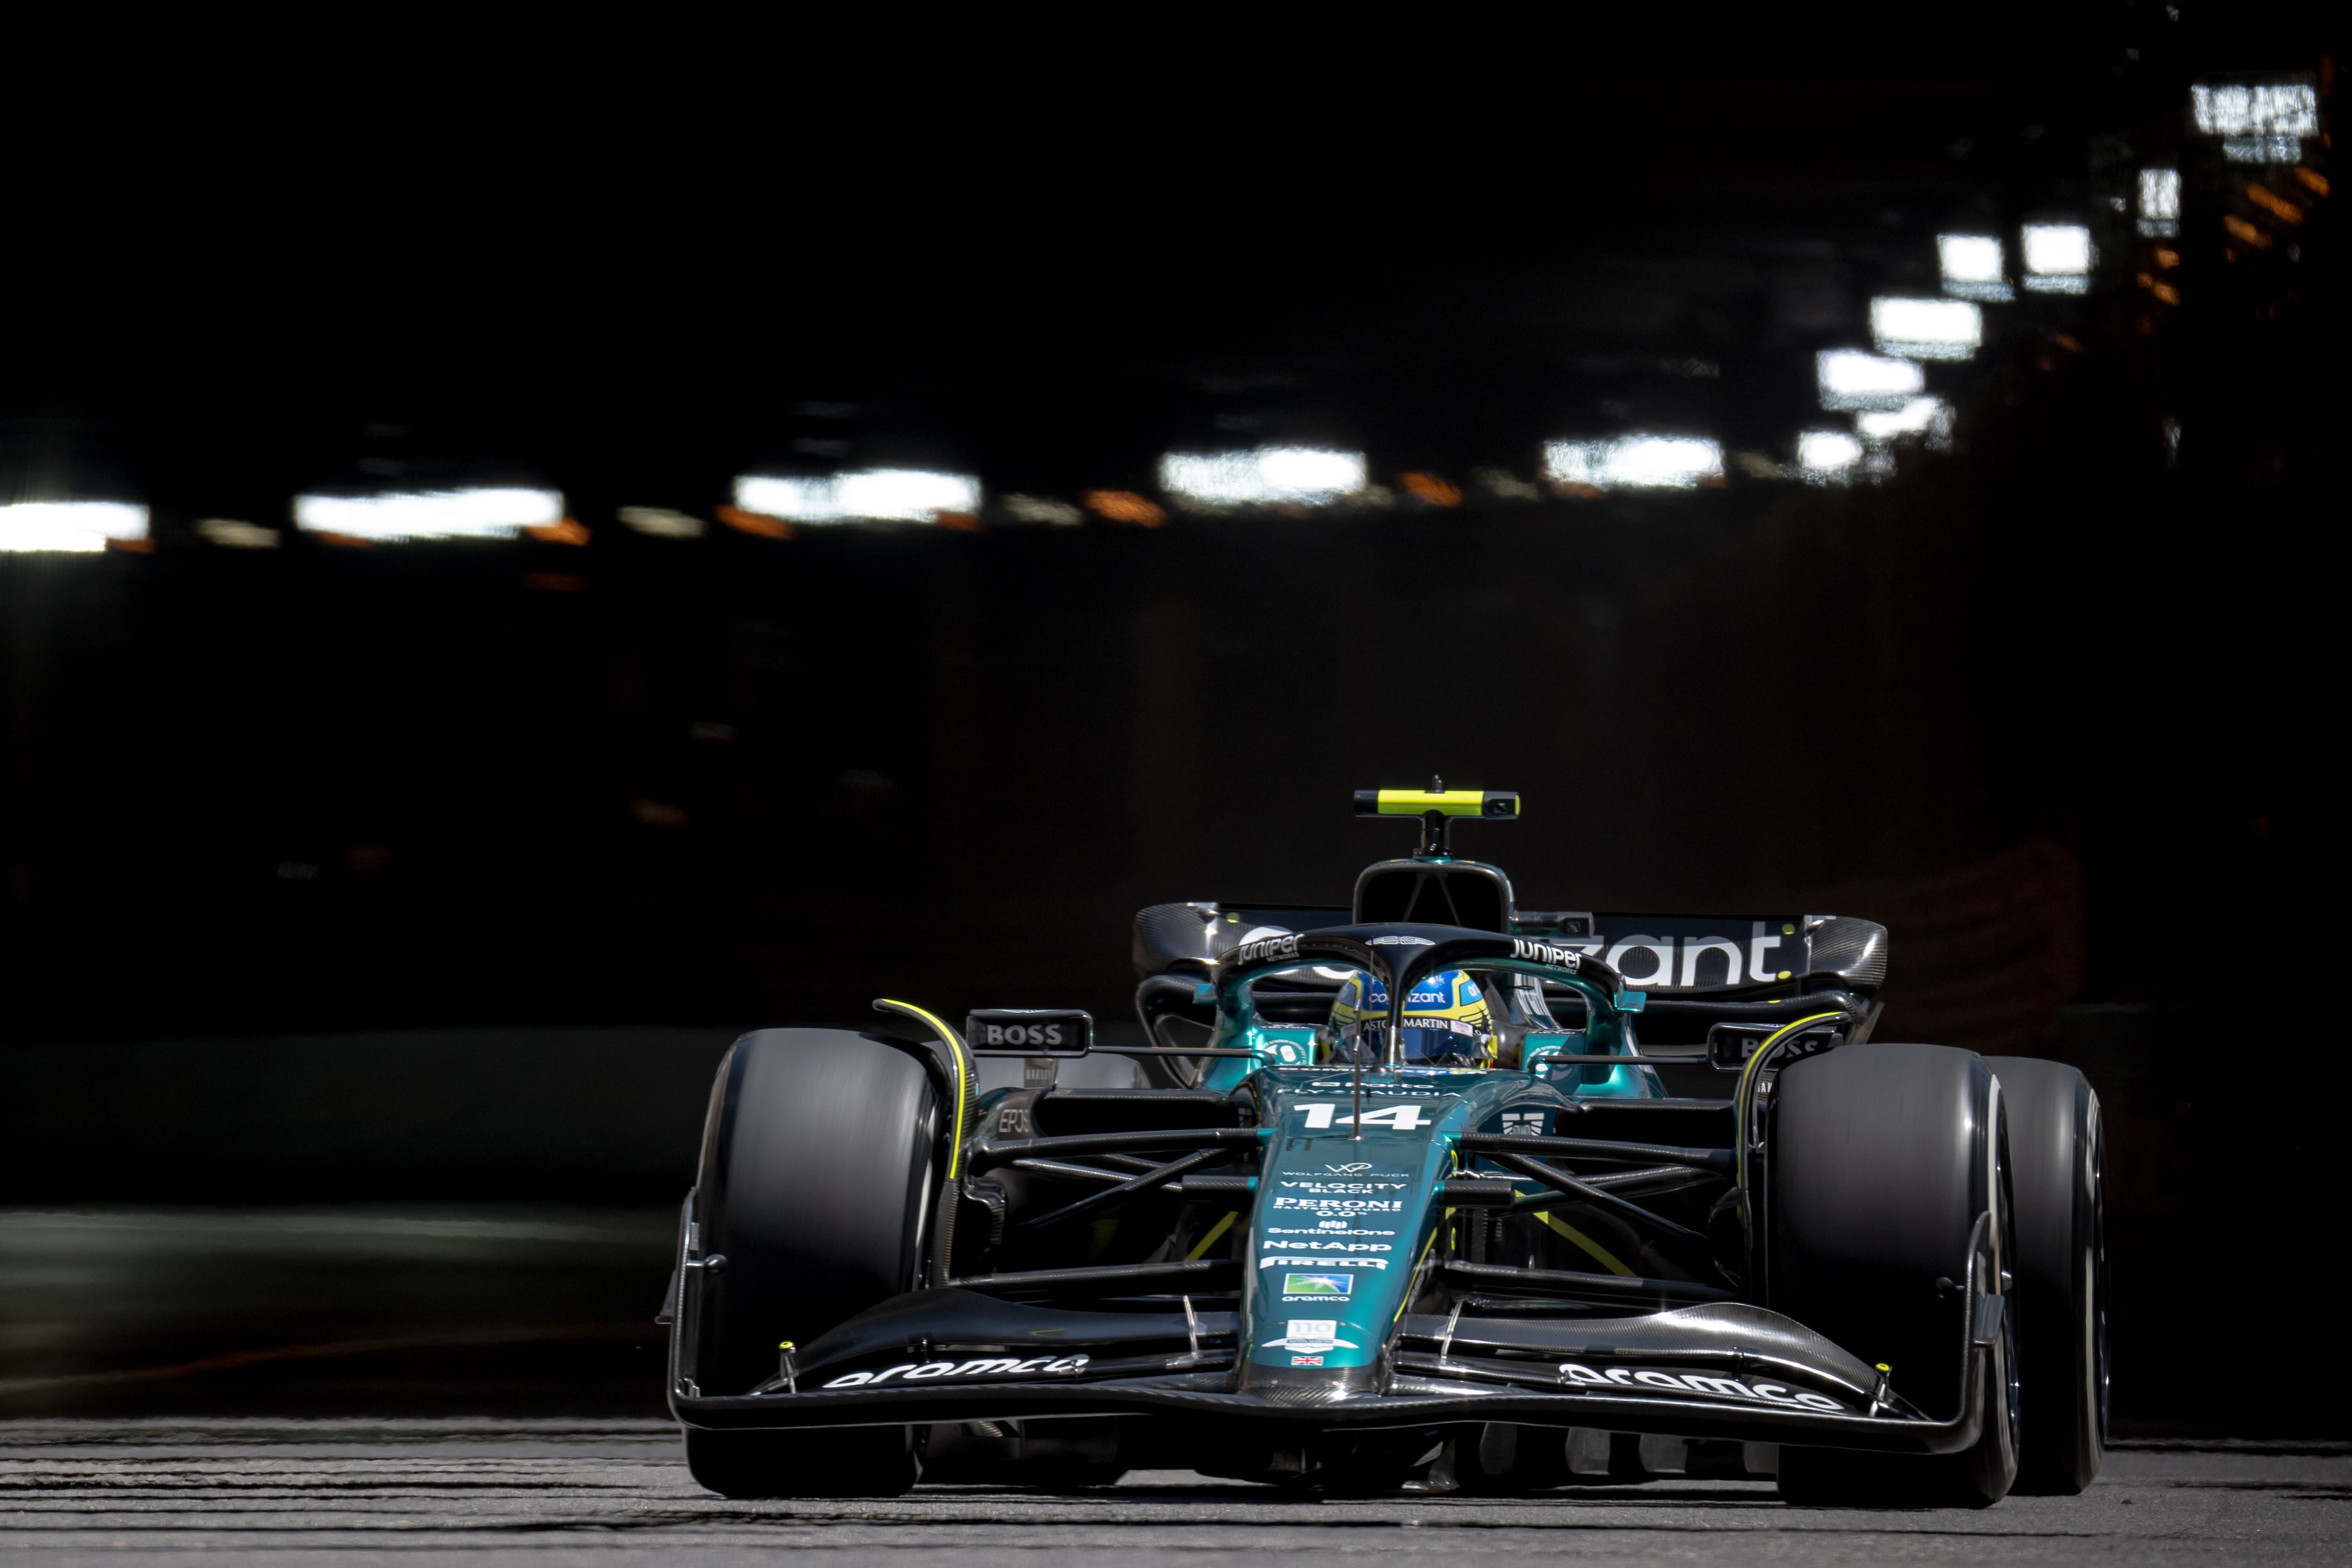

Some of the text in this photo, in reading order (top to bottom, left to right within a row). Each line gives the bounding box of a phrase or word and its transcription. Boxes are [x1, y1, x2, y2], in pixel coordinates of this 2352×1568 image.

[1404, 1018, 1448, 1029] MARTIN
[987, 1024, 1063, 1046] BOSS
[1294, 1103, 1432, 1130] 14
[1280, 1181, 1407, 1189] VELOCITY
[1273, 1197, 1403, 1209] PERONI
[1267, 1227, 1396, 1236] SentinelOne
[1263, 1240, 1392, 1252] NetApp
[1259, 1256, 1389, 1270] PIRELLI
[1292, 1322, 1332, 1333] 110
[822, 1354, 1090, 1388] aramco
[1559, 1363, 1845, 1410] aramco
